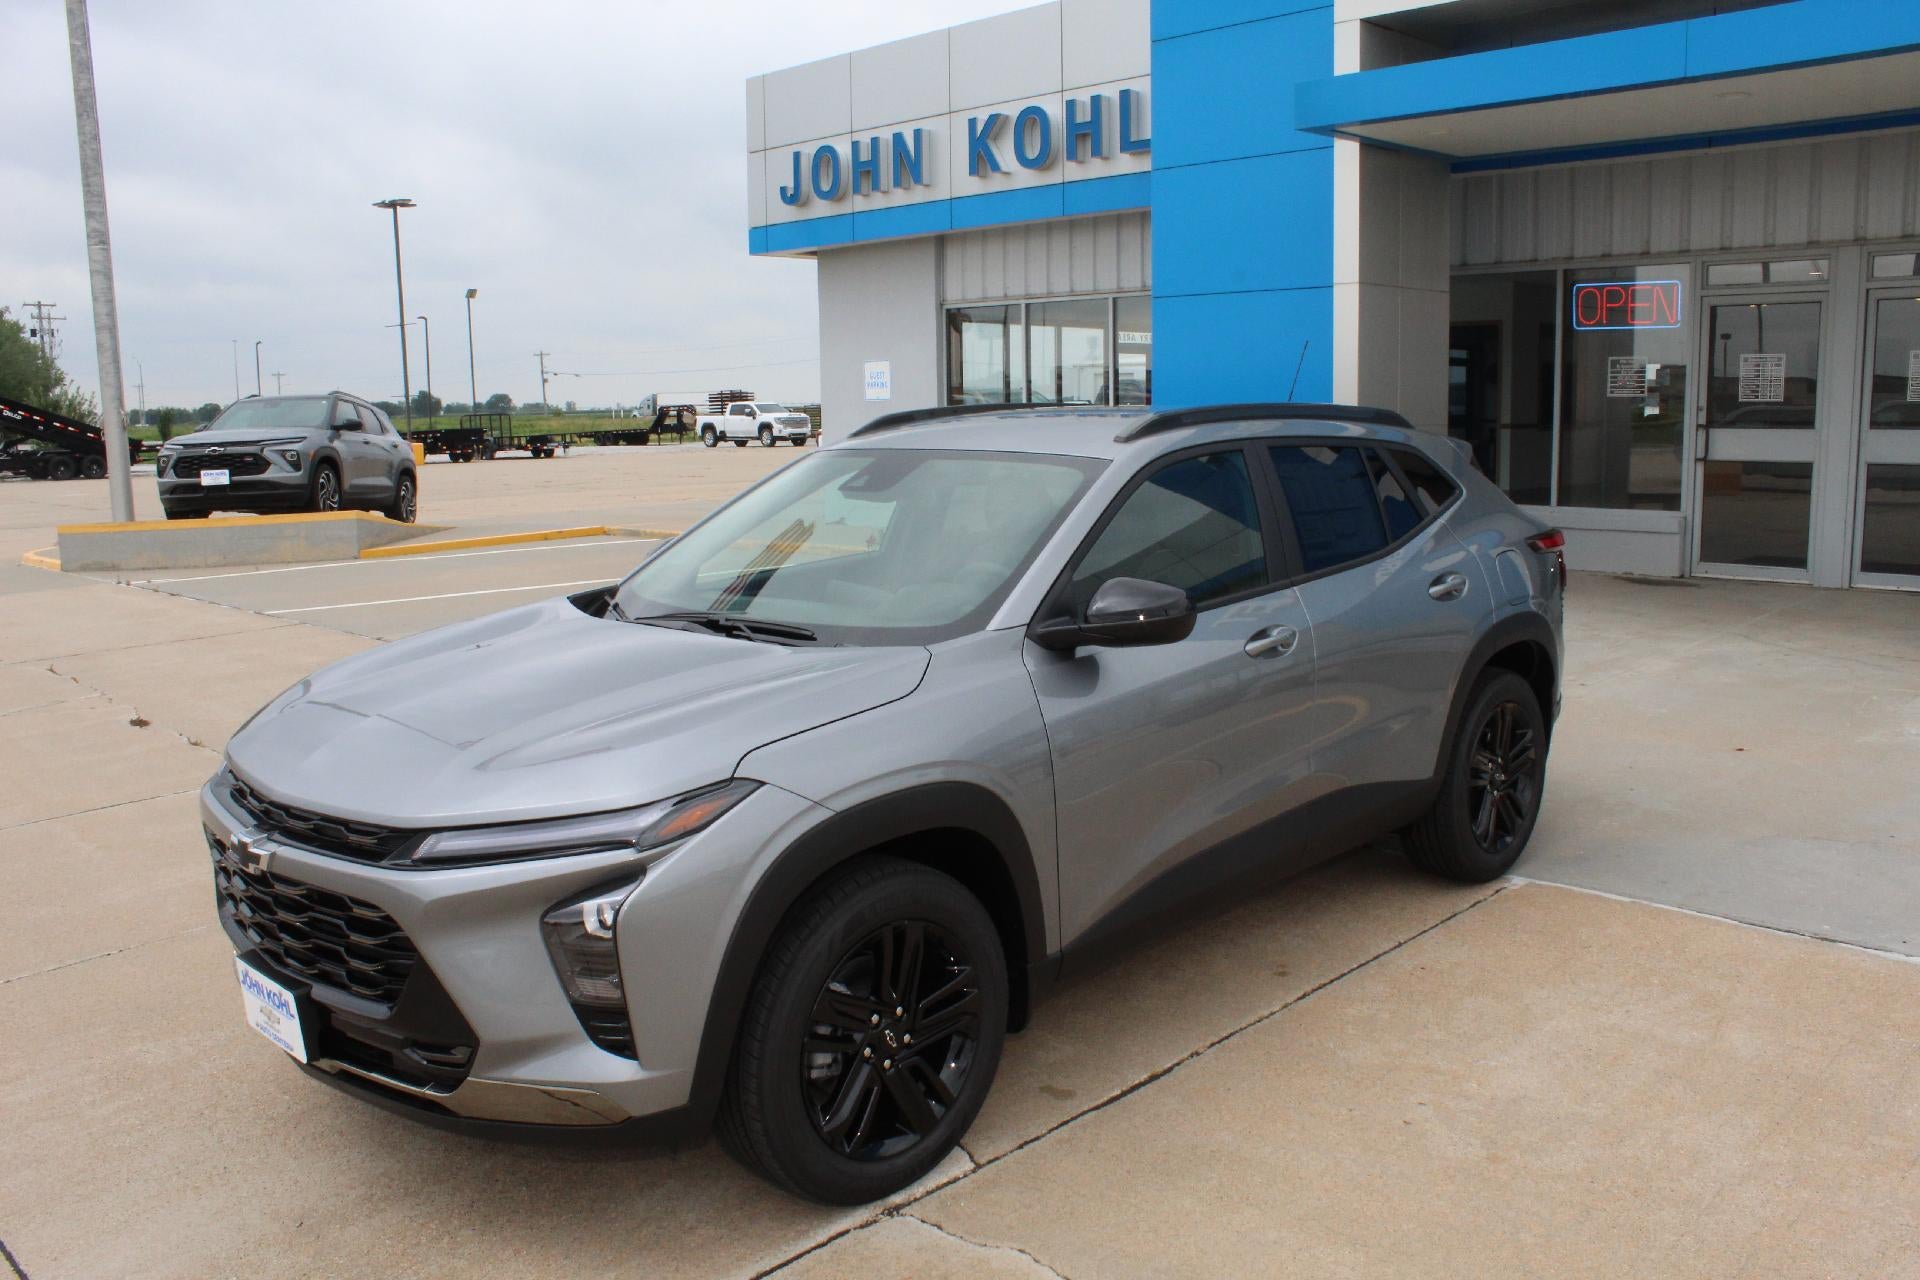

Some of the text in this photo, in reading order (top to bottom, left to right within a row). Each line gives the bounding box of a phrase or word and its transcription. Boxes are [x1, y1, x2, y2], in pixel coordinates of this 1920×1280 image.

[780, 88, 1151, 206] JOHN KOHL
[1578, 284, 1677, 324] OPEN
[864, 380, 888, 390] PARKING
[870, 370, 885, 380] GUEST
[241, 968, 296, 1019] JOHN KOHL
